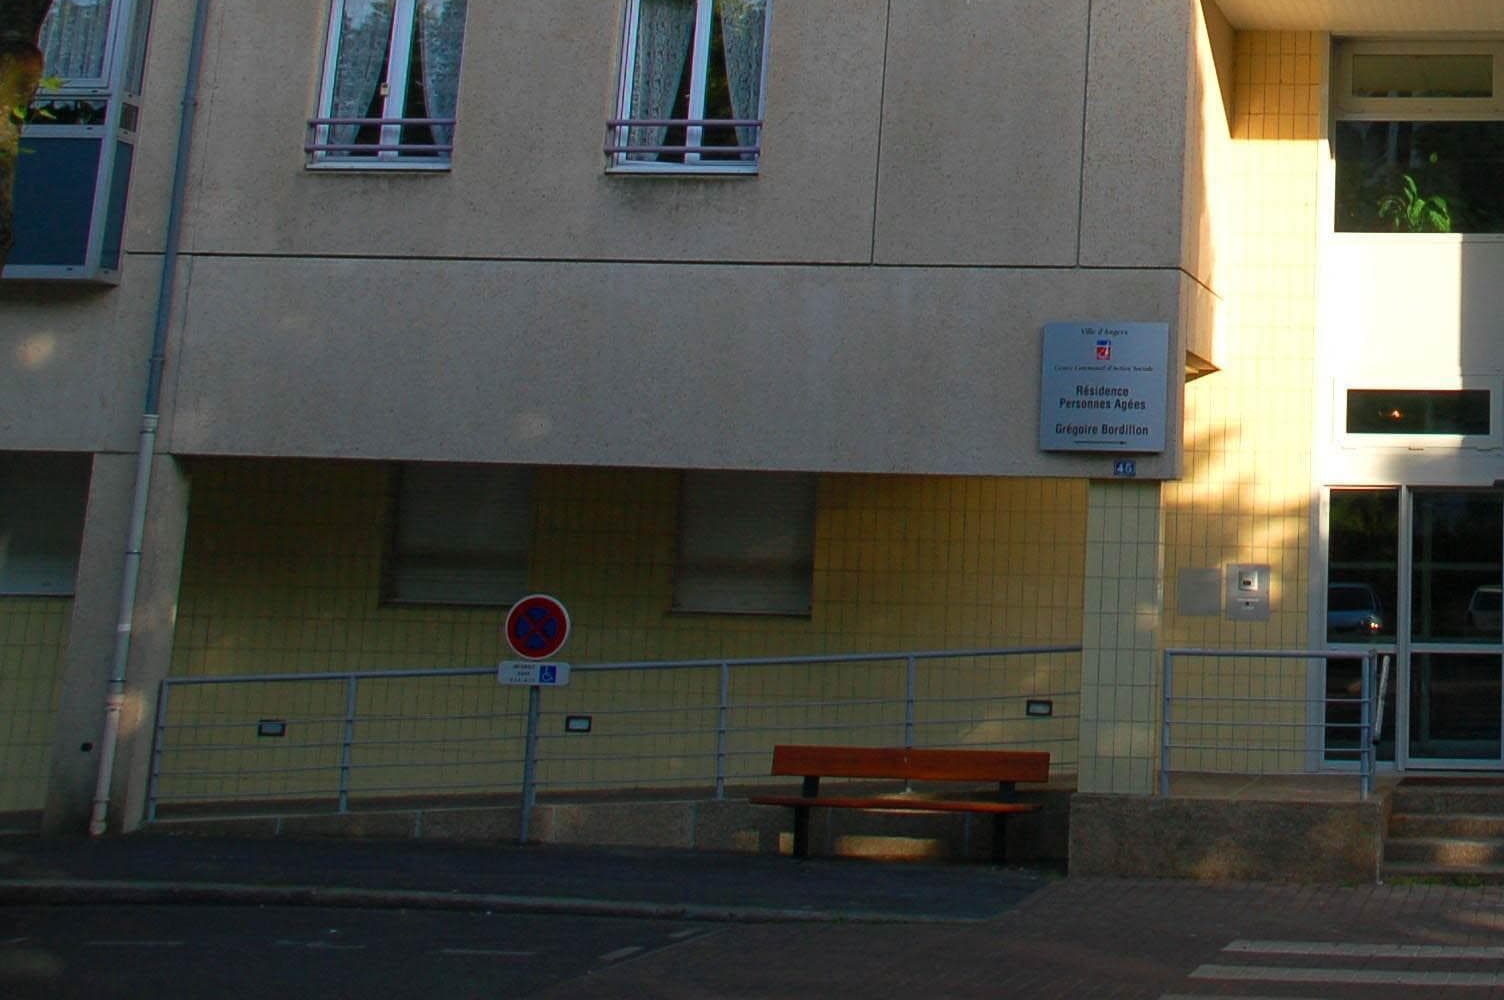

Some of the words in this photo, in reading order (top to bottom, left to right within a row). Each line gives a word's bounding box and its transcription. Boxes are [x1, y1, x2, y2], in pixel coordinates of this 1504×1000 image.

[1081, 328, 1096, 336] Ville
[1076, 384, 1129, 396] Résidence
[1059, 398, 1111, 409] Personnes
[1056, 424, 1098, 437] Grégoire
[1101, 424, 1149, 435] Bordillon
